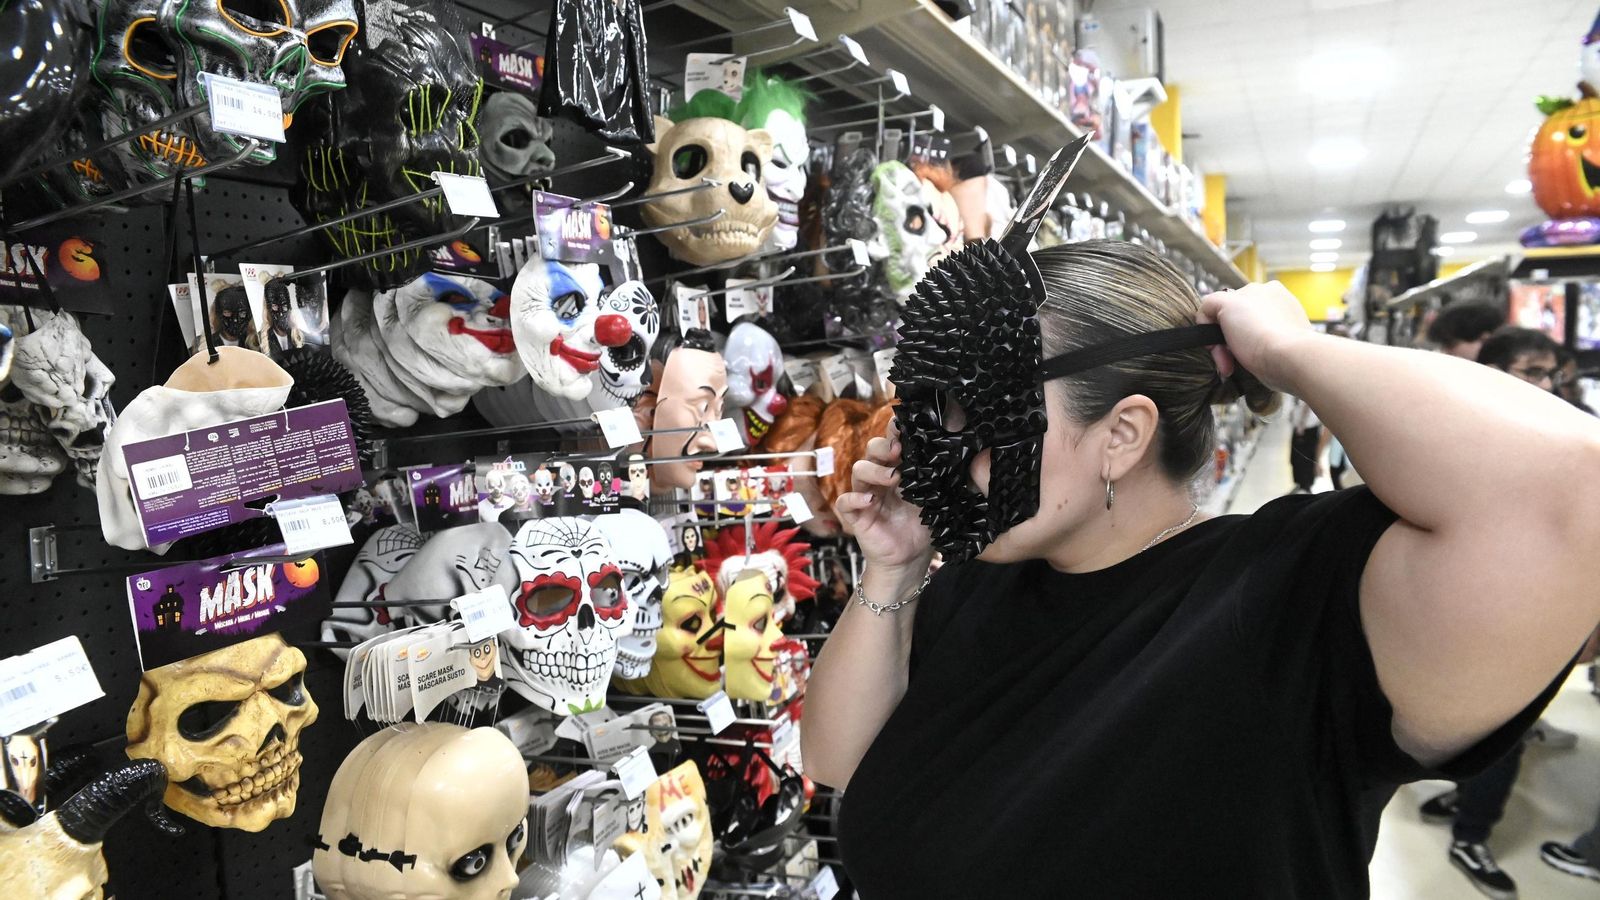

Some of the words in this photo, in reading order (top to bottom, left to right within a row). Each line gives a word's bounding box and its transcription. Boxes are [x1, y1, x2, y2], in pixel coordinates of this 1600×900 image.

[499, 53, 533, 79] MASK
[561, 210, 592, 240] MASK
[450, 474, 478, 507] MA
[200, 563, 274, 622] MASK
[418, 670, 437, 685] SCARE
[437, 664, 454, 677] MASK
[447, 668, 466, 681] SUSTO
